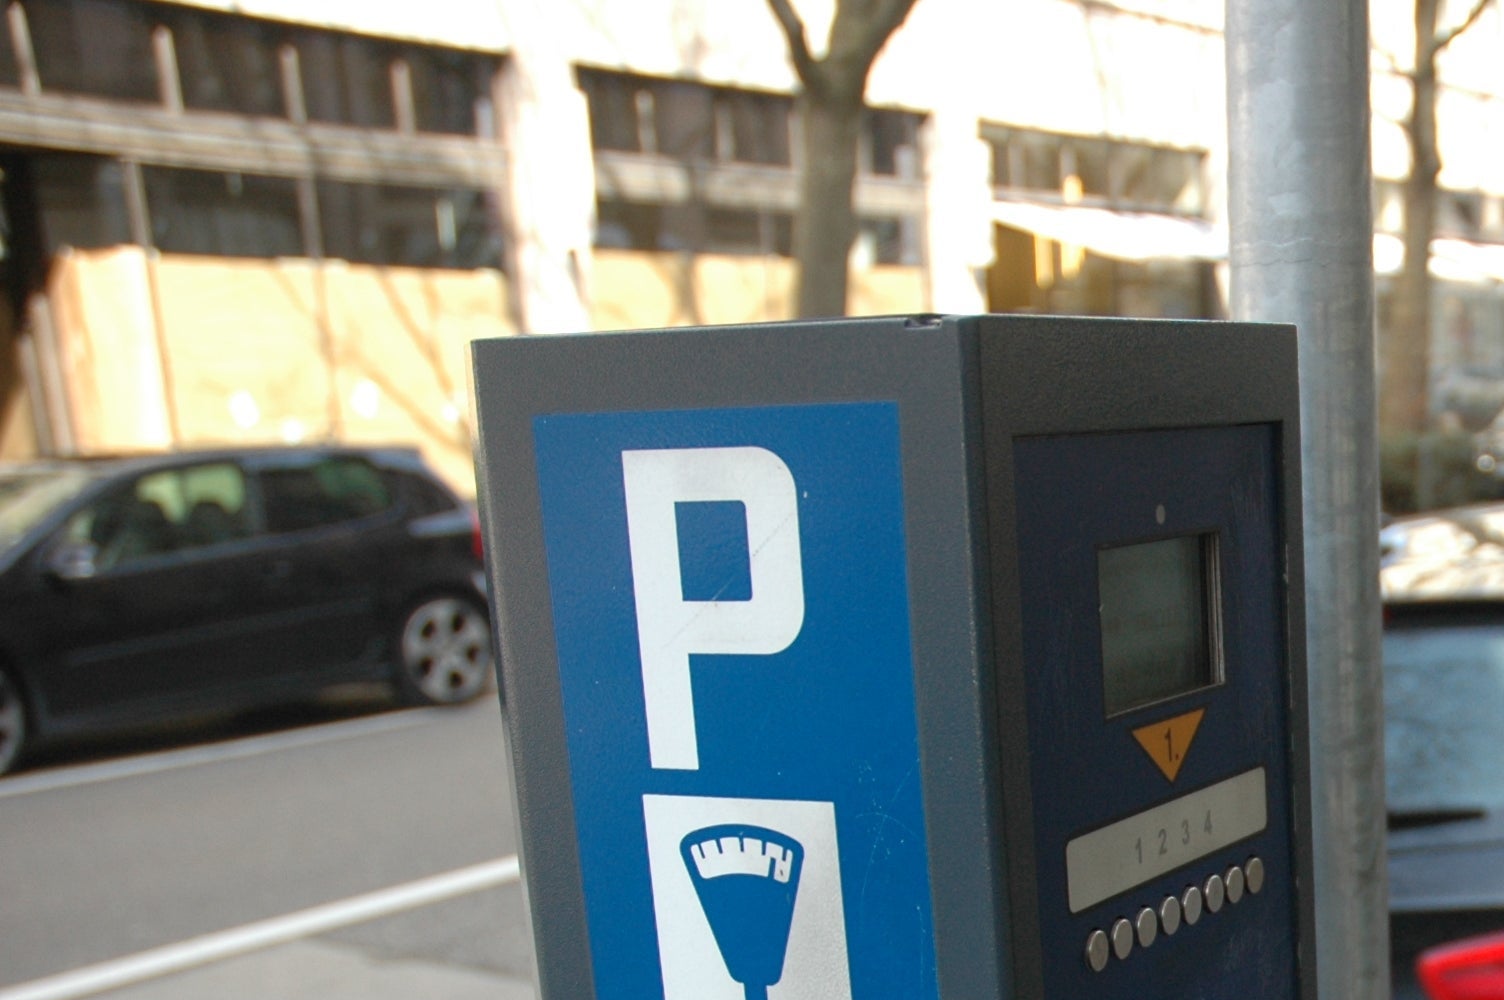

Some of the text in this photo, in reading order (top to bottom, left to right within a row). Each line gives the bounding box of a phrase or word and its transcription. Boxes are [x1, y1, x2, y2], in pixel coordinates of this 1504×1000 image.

[622, 445, 805, 770] P
[1164, 728, 1180, 762] 1.
[1135, 809, 1213, 864] 1 2 3 4
